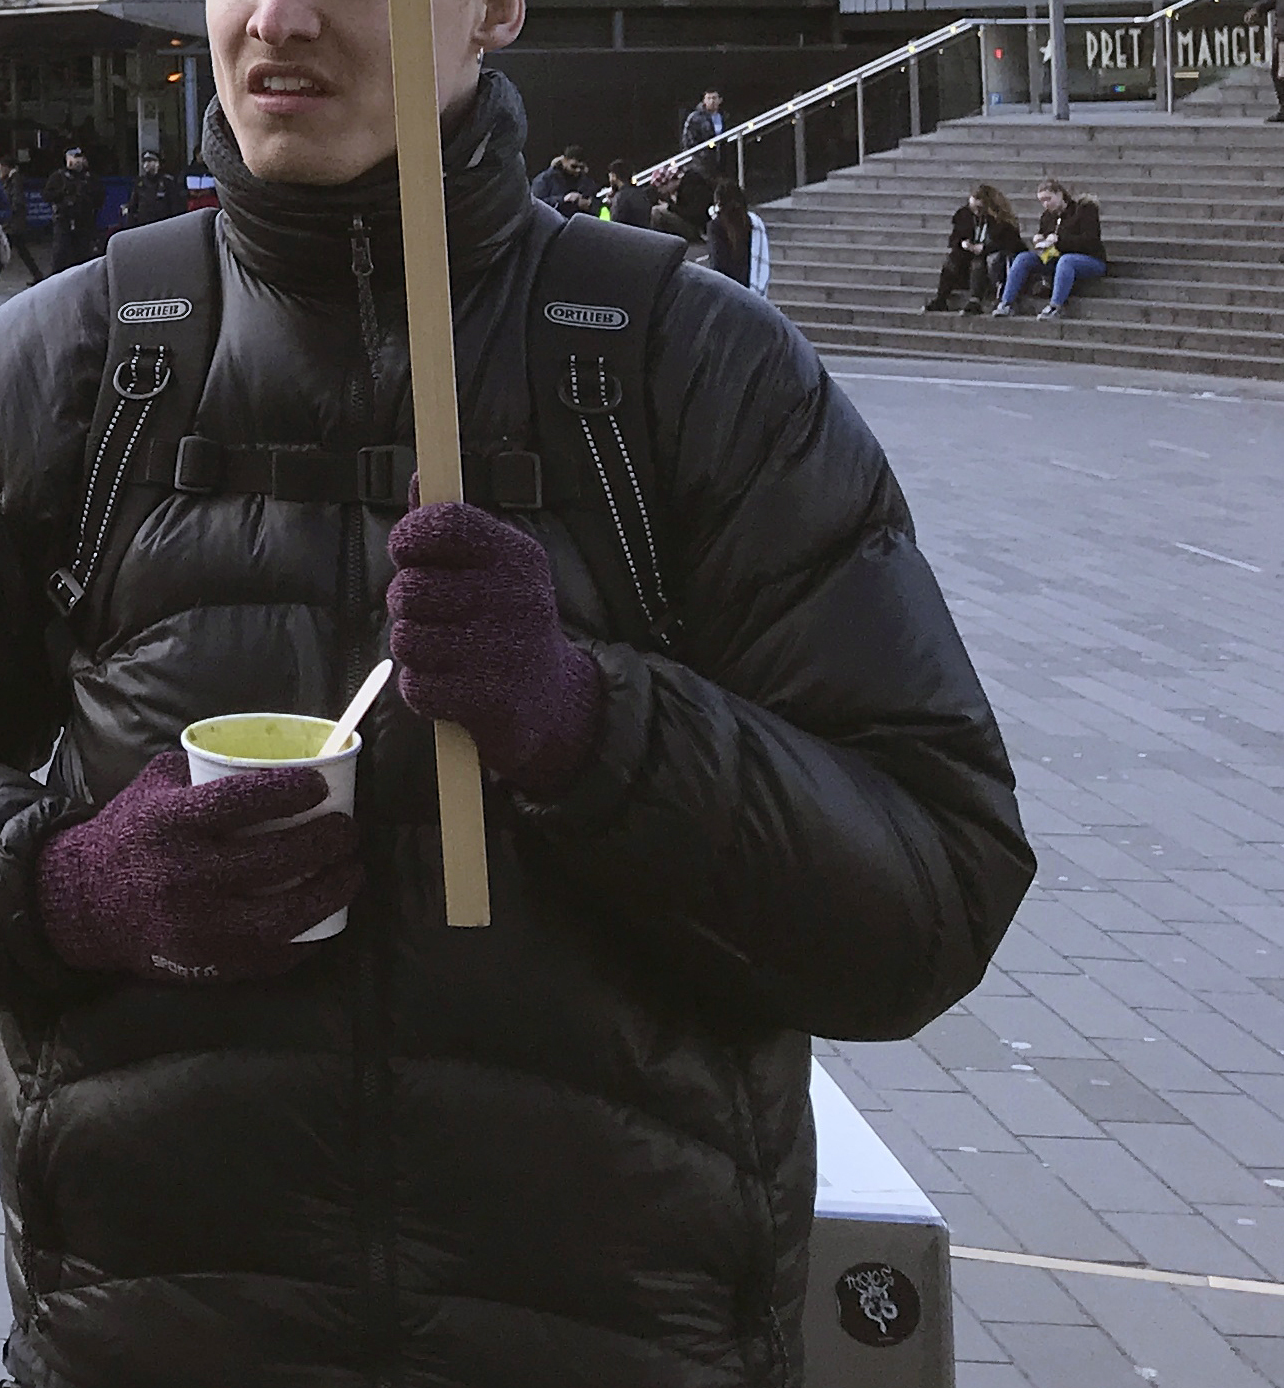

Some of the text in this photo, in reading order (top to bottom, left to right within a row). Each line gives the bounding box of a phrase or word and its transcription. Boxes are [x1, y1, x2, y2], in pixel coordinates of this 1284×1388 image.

[1086, 27, 1143, 70] PRET
[125, 304, 180, 317] ORTLIEB
[553, 308, 615, 323] ORTLIEB
